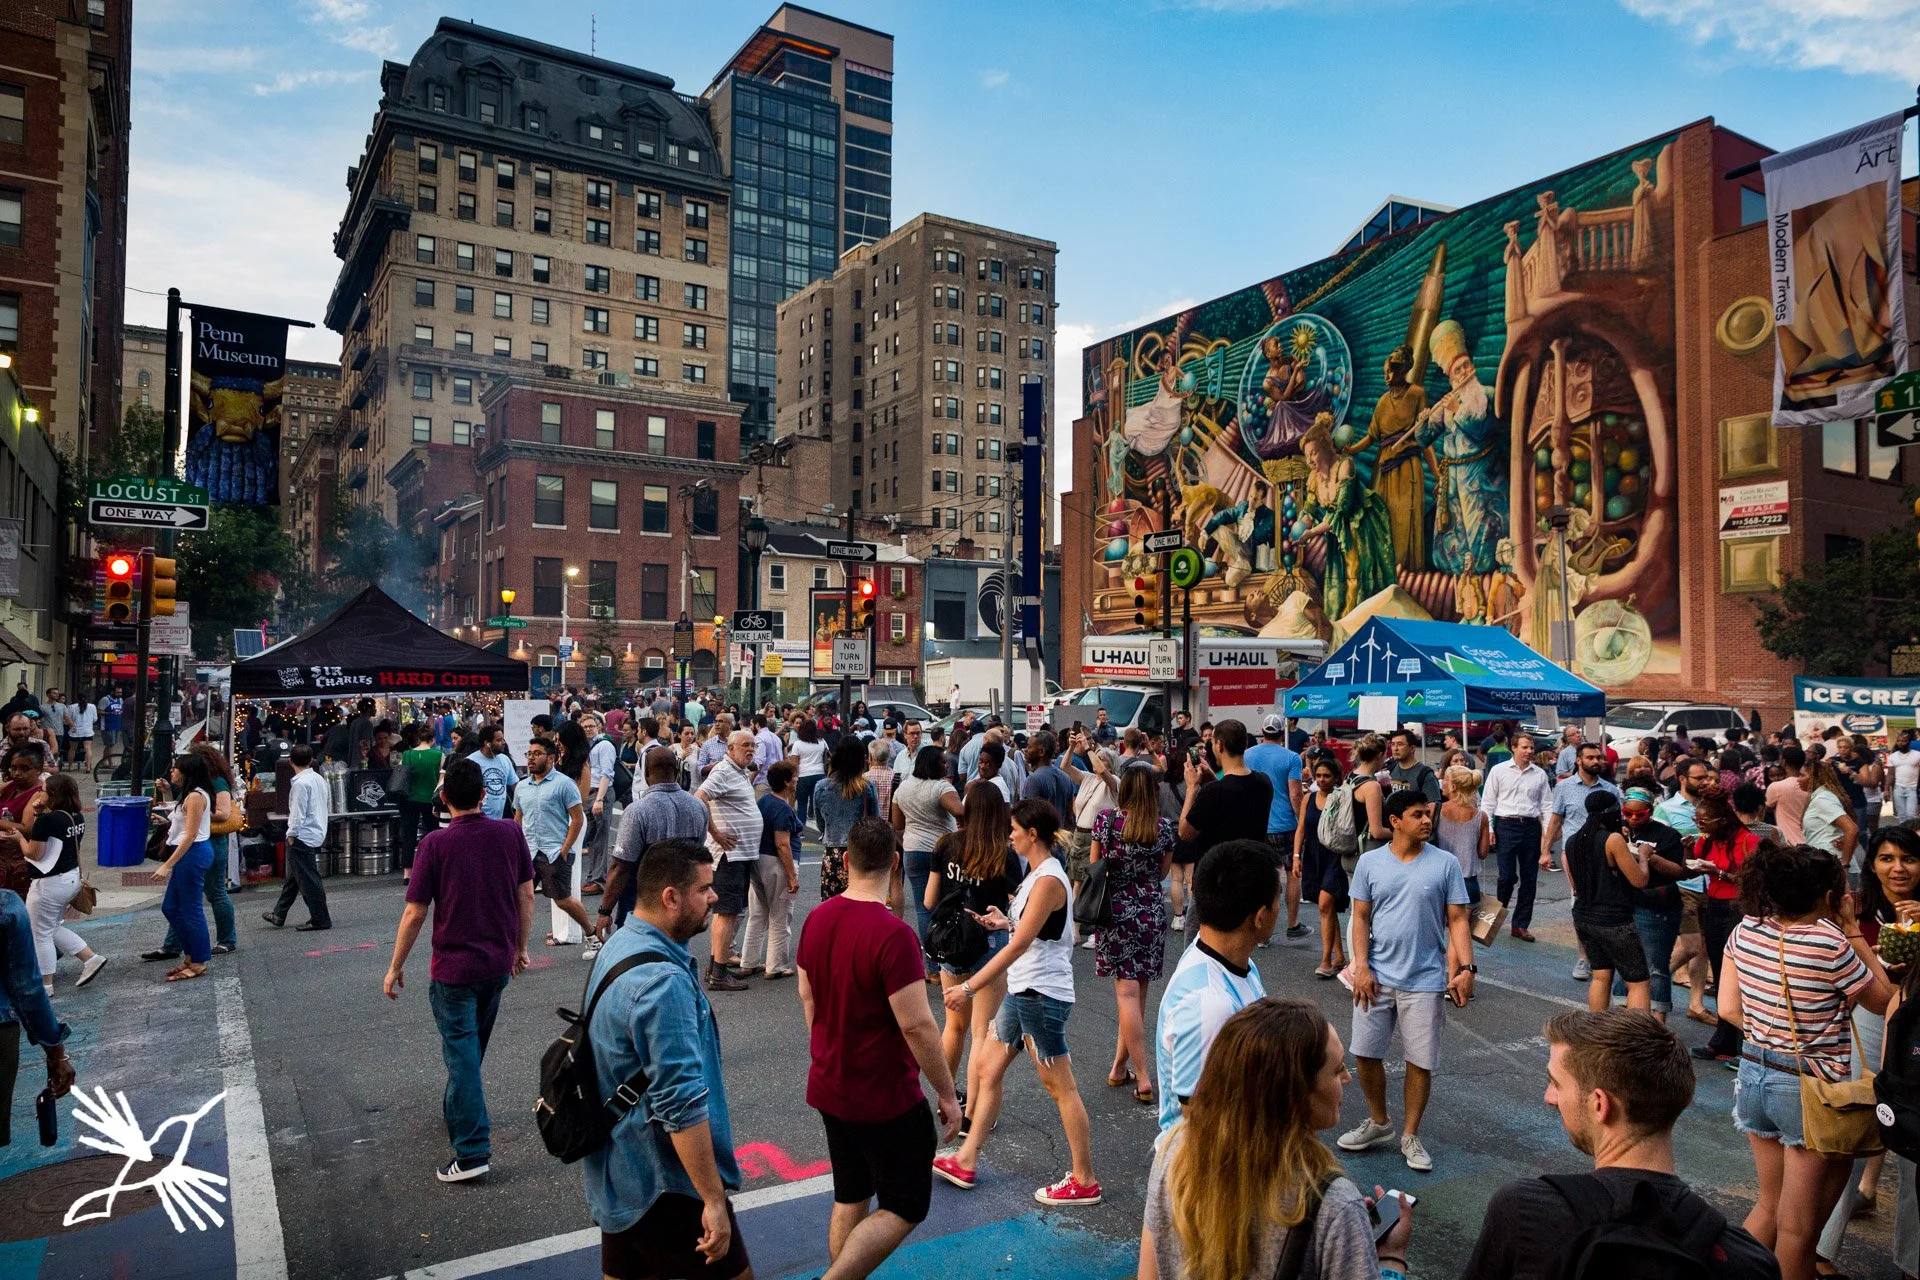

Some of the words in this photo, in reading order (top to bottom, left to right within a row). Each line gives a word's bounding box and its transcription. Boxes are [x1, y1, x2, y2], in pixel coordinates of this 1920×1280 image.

[1856, 144, 1896, 174] Art
[1775, 213, 1790, 272] Modern
[1776, 276, 1790, 321] Times
[199, 322, 244, 344] Penn
[199, 342, 278, 368] Museum
[96, 483, 180, 502] LOCUST
[188, 494, 200, 503] ST
[106, 507, 136, 518] ONE
[142, 510, 174, 520] WAY
[1742, 504, 1776, 513] LEASE
[1744, 515, 1782, 525] 568-7222
[1155, 538, 1166, 547] ONE
[1167, 535, 1178, 545] WAY
[848, 547, 862, 555] WAY
[735, 632, 750, 641] BIKE
[753, 631, 771, 641] LANE
[1092, 650, 1149, 664] U-HAU
[1209, 652, 1268, 666] U-HAUL
[1461, 645, 1508, 659] Green
[848, 663, 864, 671] RED
[1474, 656, 1545, 669] Mountain
[310, 666, 342, 677] SIR
[379, 671, 435, 686] HARD
[1151, 667, 1161, 676] ON
[1162, 668, 1174, 677] RED
[1488, 667, 1544, 681] Energy
[1491, 691, 1520, 701] CHOOSE
[1522, 692, 1560, 701] POLLUTION
[1804, 688, 1846, 704] ICE
[1502, 704, 1536, 712] ELECTRIC
[1878, 1107, 1892, 1122] LOVE
